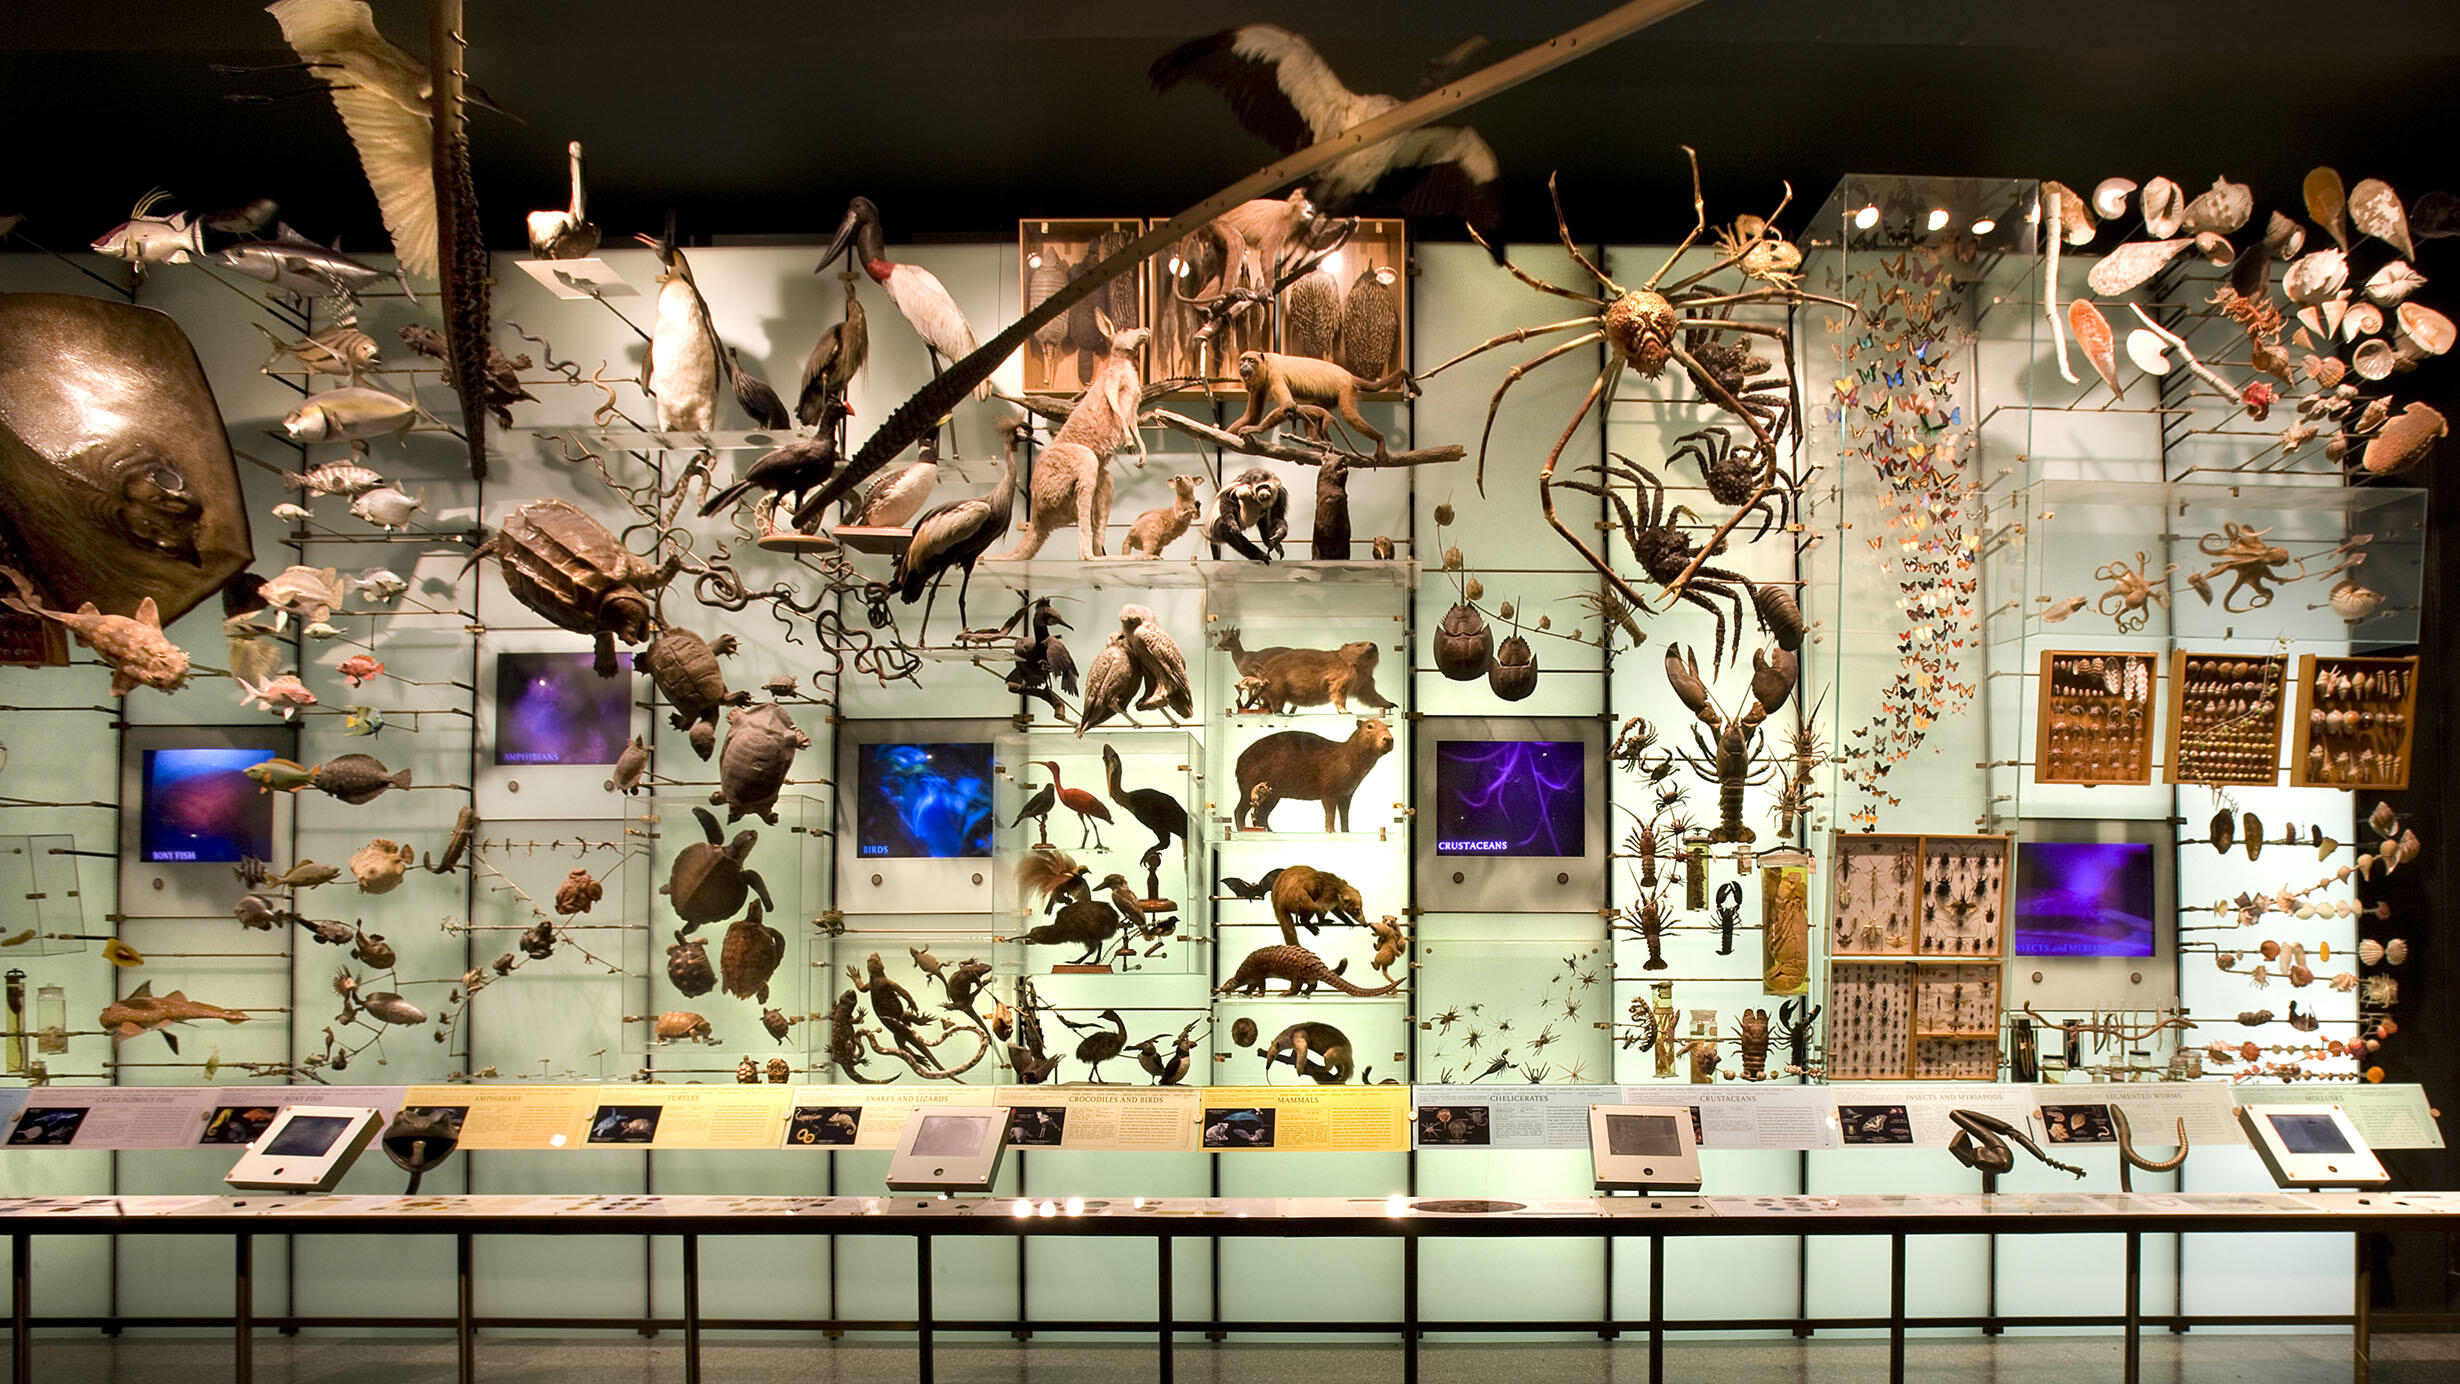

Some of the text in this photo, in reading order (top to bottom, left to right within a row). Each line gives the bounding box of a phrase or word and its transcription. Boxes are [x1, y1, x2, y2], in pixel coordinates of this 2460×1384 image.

[504, 752, 560, 761] AMPHIBIANS
[863, 845, 888, 854] BIRDS
[1438, 841, 1508, 850] CRUSTACEANS
[152, 851, 196, 860] BONY FISH
[2015, 943, 2049, 952] NSECTS
[2051, 943, 2066, 952] and
